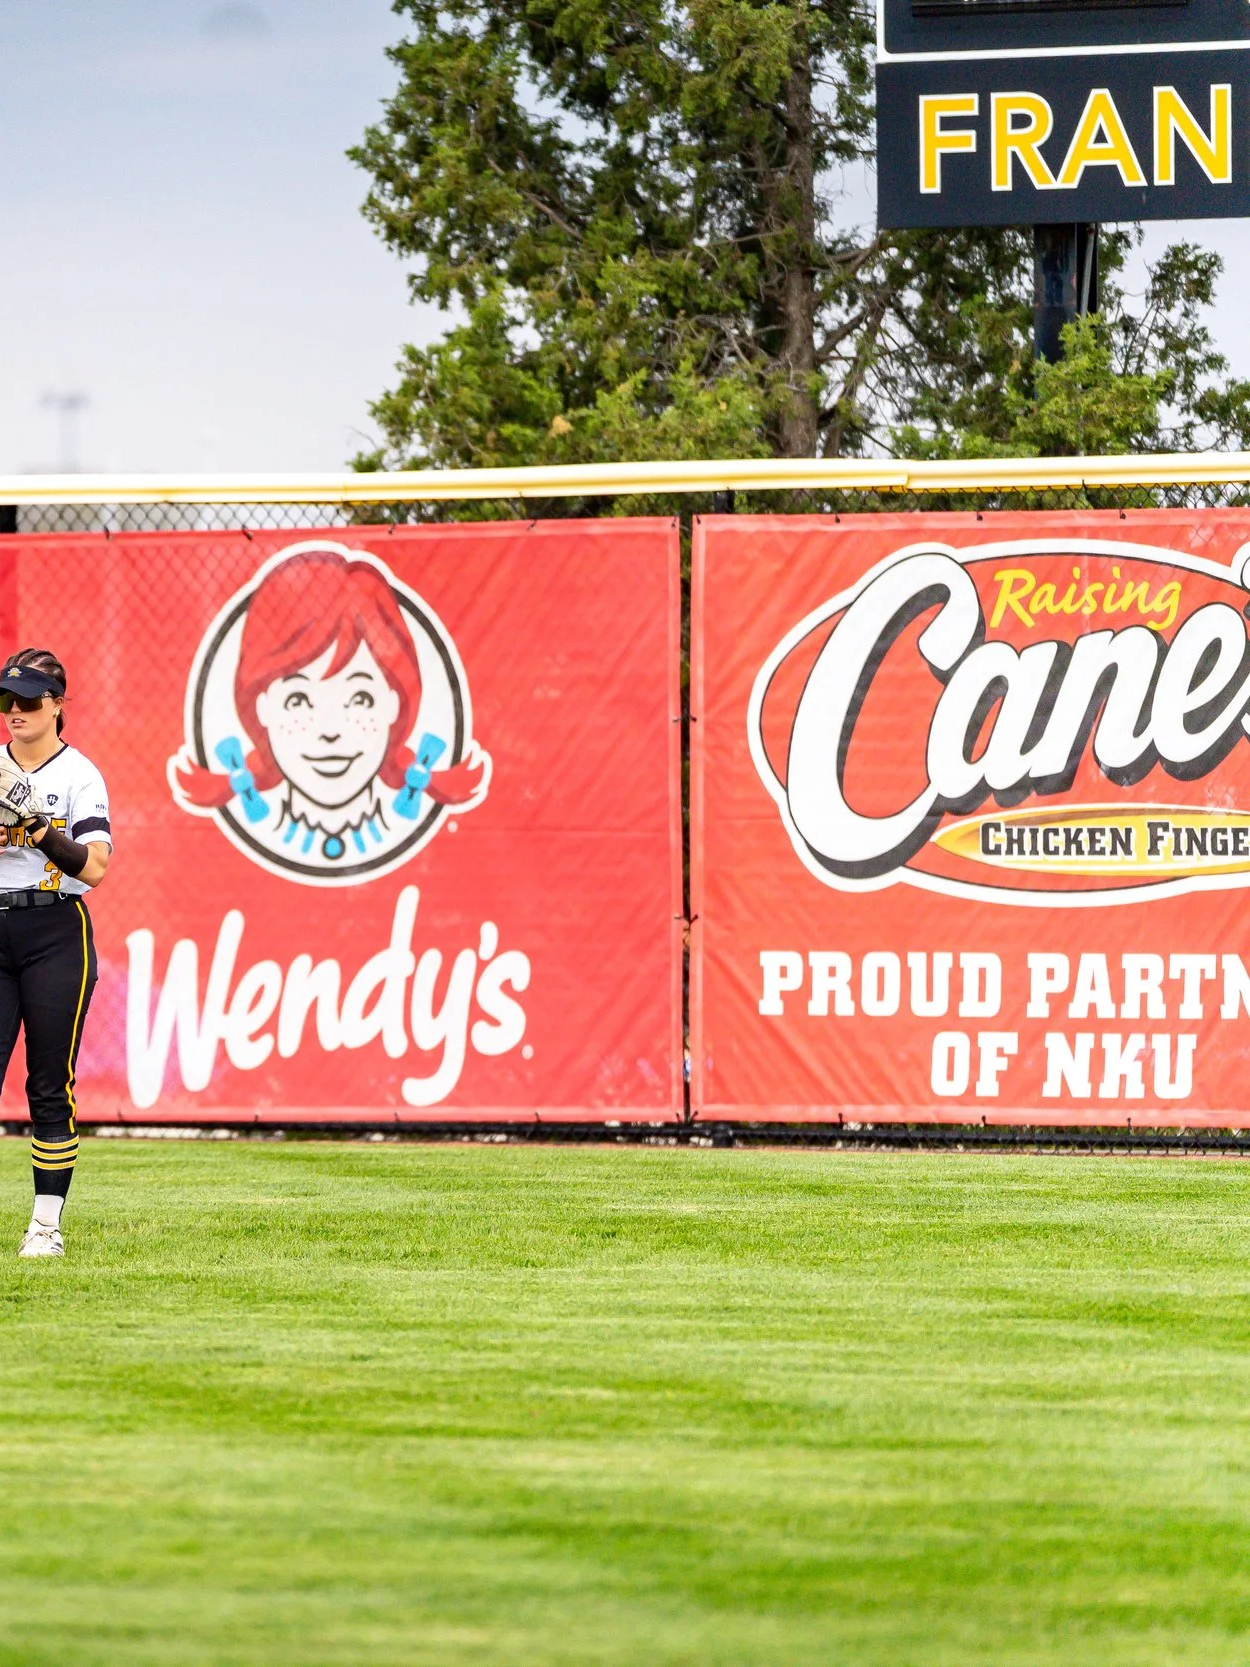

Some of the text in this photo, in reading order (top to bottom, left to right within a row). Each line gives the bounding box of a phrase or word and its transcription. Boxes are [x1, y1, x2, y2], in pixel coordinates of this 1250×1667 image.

[919, 83, 1233, 194] FRAN
[990, 568, 1182, 631] Raising
[786, 550, 1250, 872] Cane
[980, 820, 1250, 858] CHICKEN FINGE
[126, 885, 532, 1109] Wendy's
[758, 951, 1003, 1017] PROUD
[930, 1031, 1198, 1100] OF NKU
